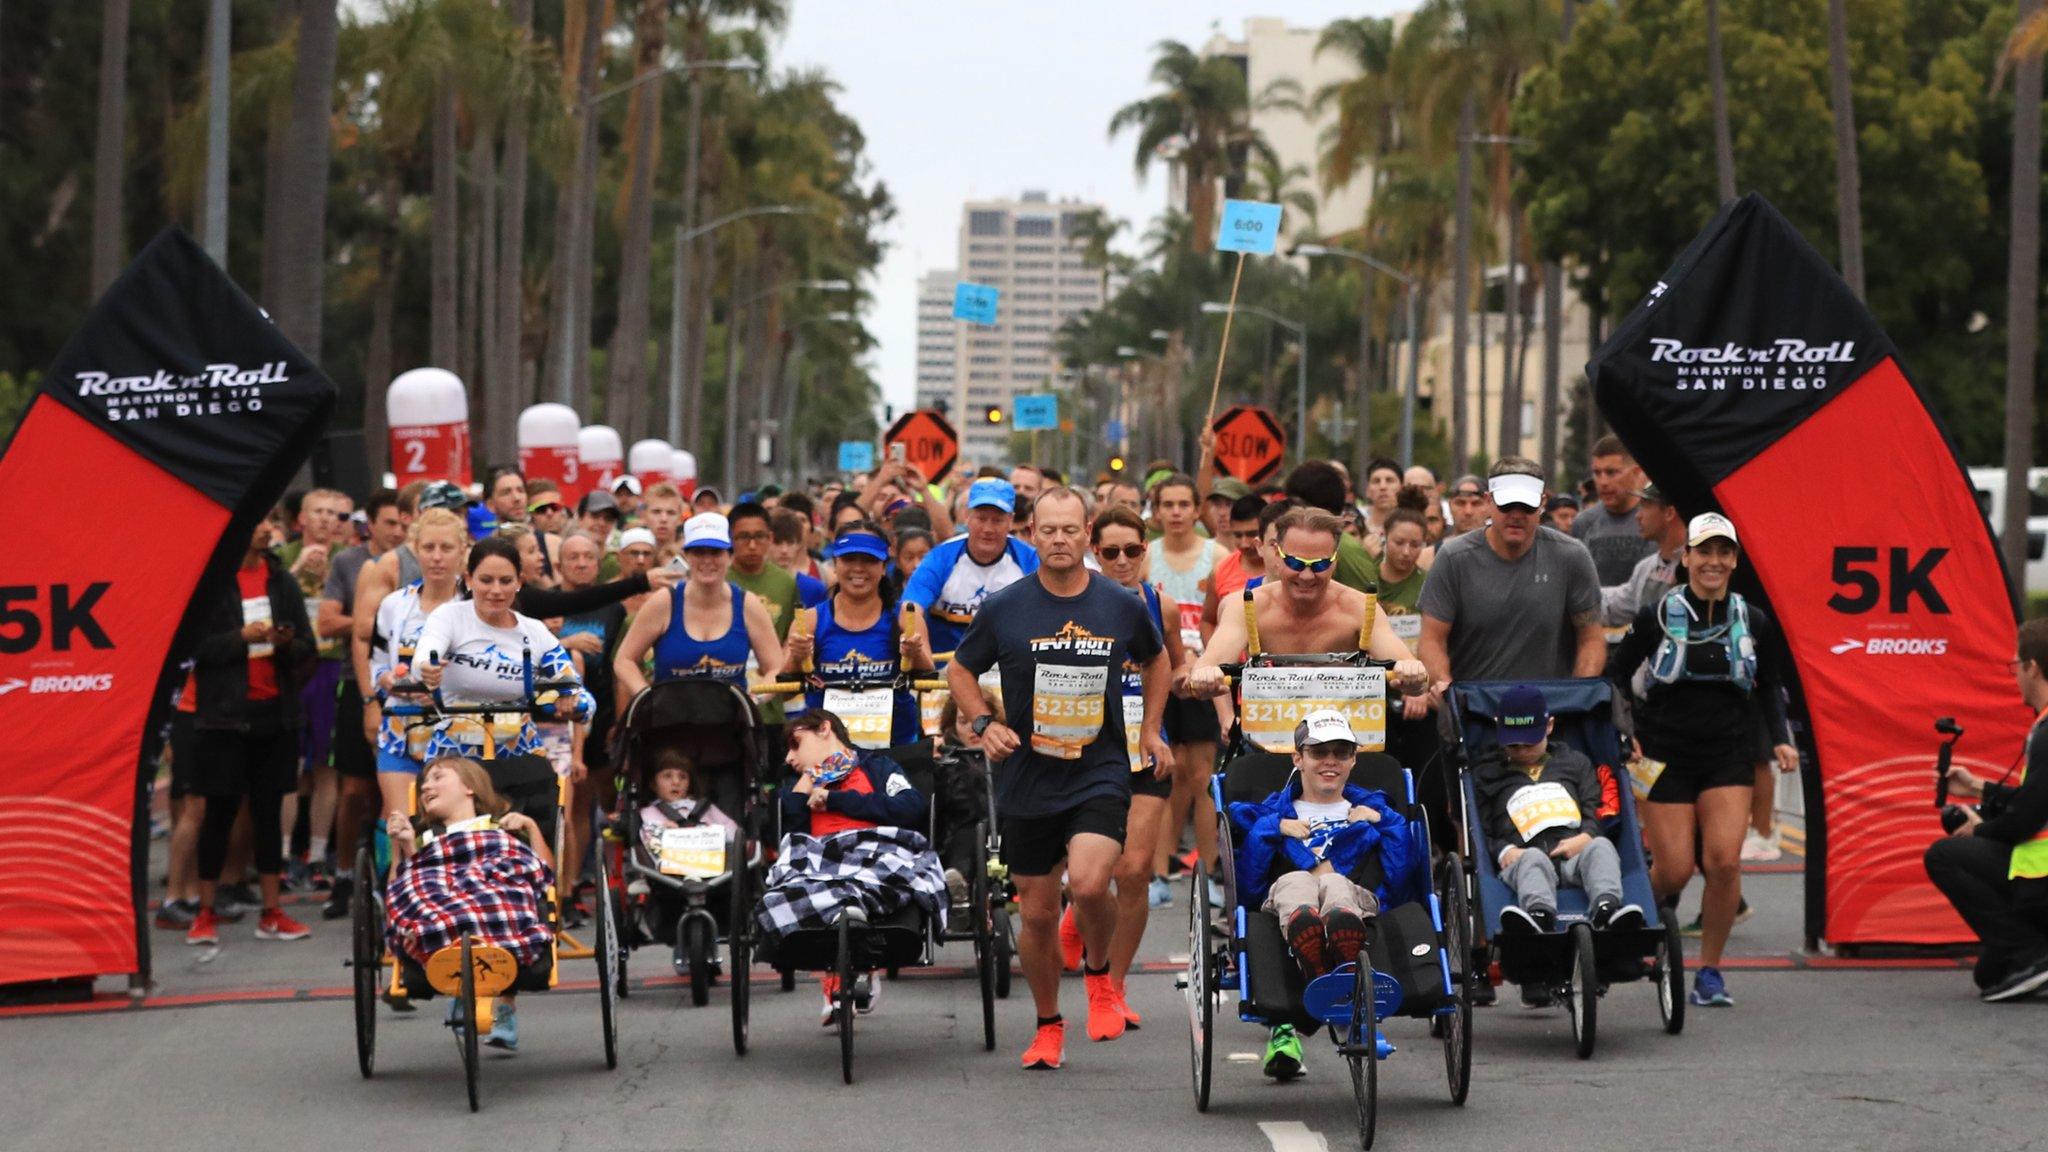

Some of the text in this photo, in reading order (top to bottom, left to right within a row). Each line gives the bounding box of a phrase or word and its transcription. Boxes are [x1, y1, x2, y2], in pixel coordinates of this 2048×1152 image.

[1234, 218, 1263, 232] 6:00
[1650, 338, 1746, 363] Rock
[1774, 338, 1855, 363] Roll
[75, 369, 178, 397] Rock
[205, 361, 290, 388] Roll
[1677, 366, 1826, 376] MARATHON & 1/2
[1676, 378, 1827, 390] SAN DIEGO
[106, 391, 199, 408] MARATHON
[230, 387, 261, 398] 1/2
[107, 399, 263, 422] SAN DIEGO
[905, 436, 945, 462] LOW
[1218, 432, 1271, 459] SLOW
[404, 440, 427, 473] 2
[562, 457, 578, 484] 3
[1826, 546, 1951, 615] 5K
[0, 582, 116, 655] 5K
[1031, 637, 1113, 652] TEAM HOYT
[1865, 637, 1948, 655] BROOKS
[447, 651, 492, 672] TEAM
[820, 662, 893, 674] TEAM HOYT
[29, 673, 114, 694] BROOKS
[1248, 674, 1278, 682] Rock
[1287, 673, 1314, 682] Roll
[1356, 673, 1382, 681] Roll
